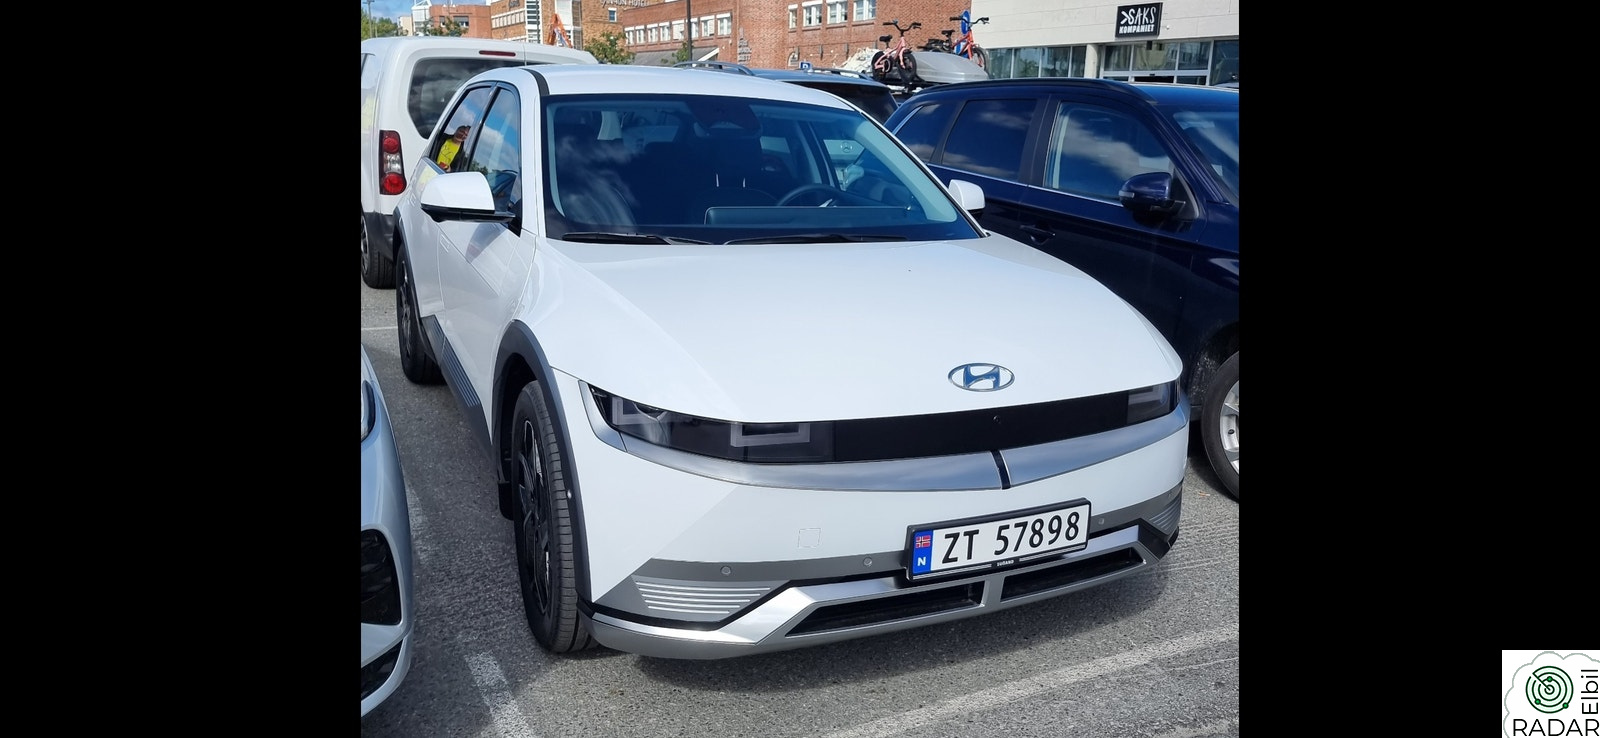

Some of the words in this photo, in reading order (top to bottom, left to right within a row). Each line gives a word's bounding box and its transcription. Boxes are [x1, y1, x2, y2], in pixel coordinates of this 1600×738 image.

[1127, 6, 1156, 25] SAKS
[1119, 24, 1155, 34] KOMPANIET
[942, 529, 979, 564] ZT
[994, 511, 1080, 556] 57898
[917, 556, 927, 567] N
